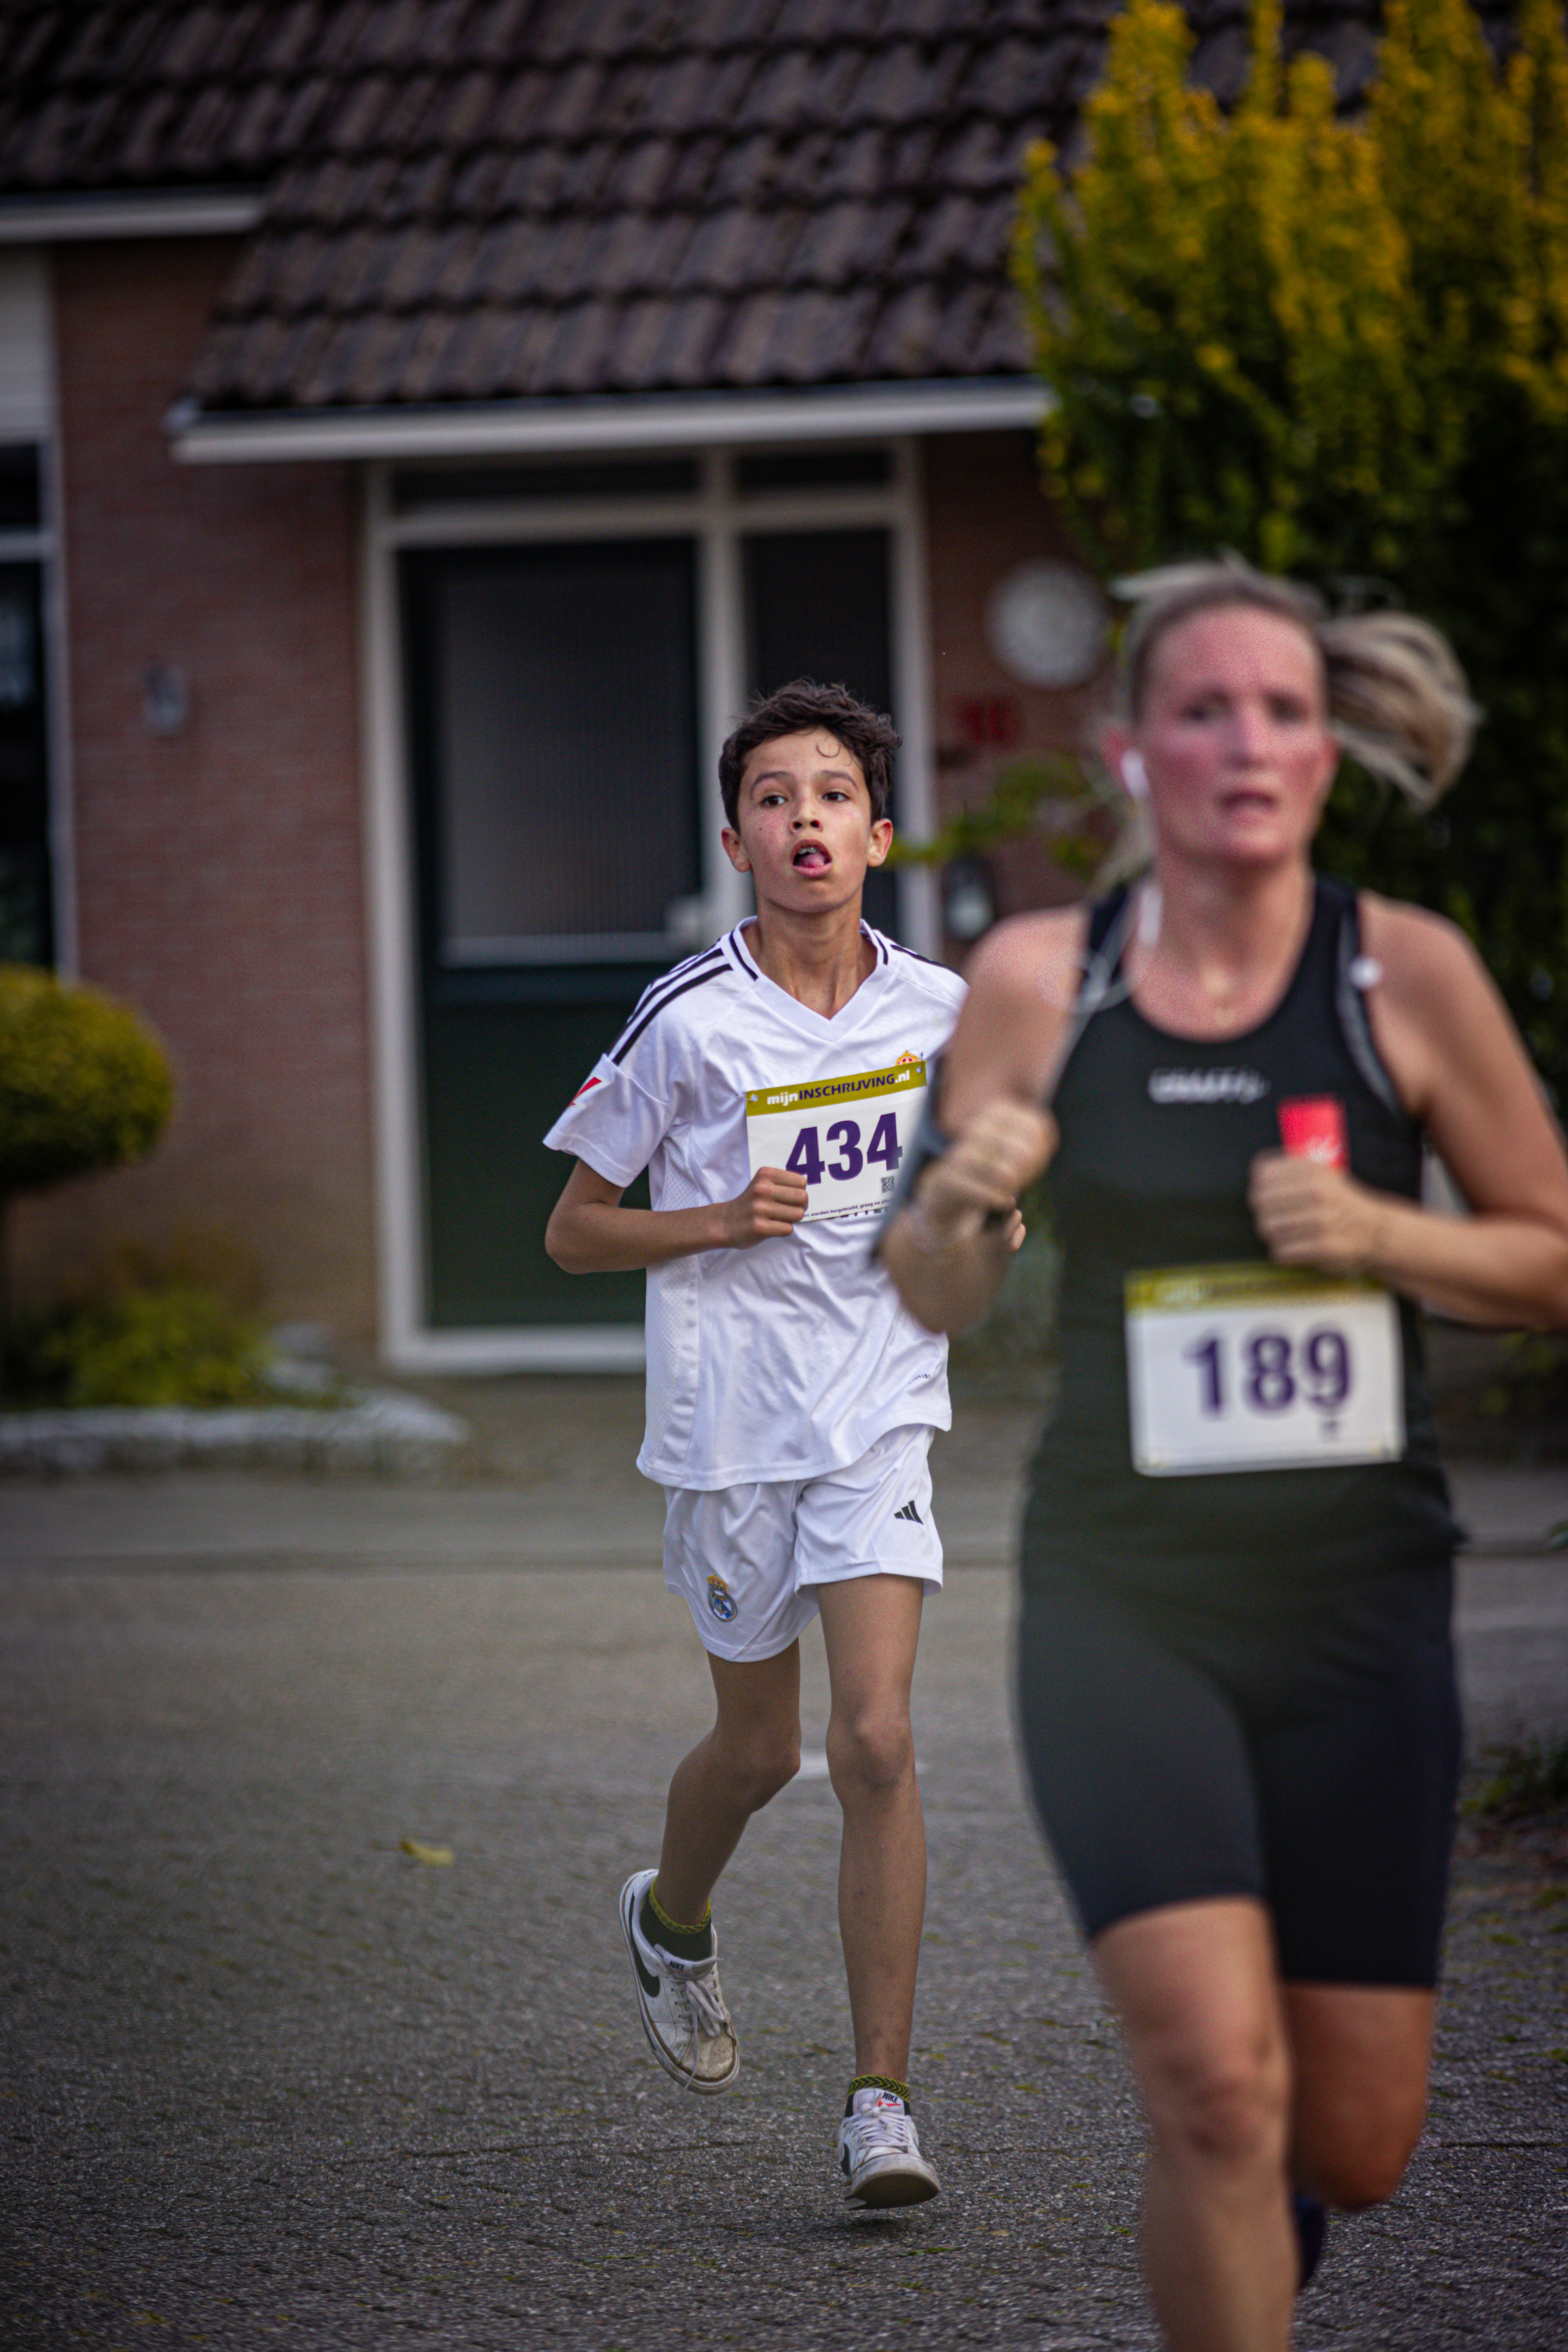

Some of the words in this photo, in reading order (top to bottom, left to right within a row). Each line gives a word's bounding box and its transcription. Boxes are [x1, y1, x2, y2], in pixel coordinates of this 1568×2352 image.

[767, 1069, 910, 1106] mijnINSCHRIJVING.nl
[786, 1112, 902, 1185] 434
[1185, 1327, 1352, 1419] 189
[670, 1960, 684, 1971] NIKE
[882, 2092, 898, 2103] NIKE
